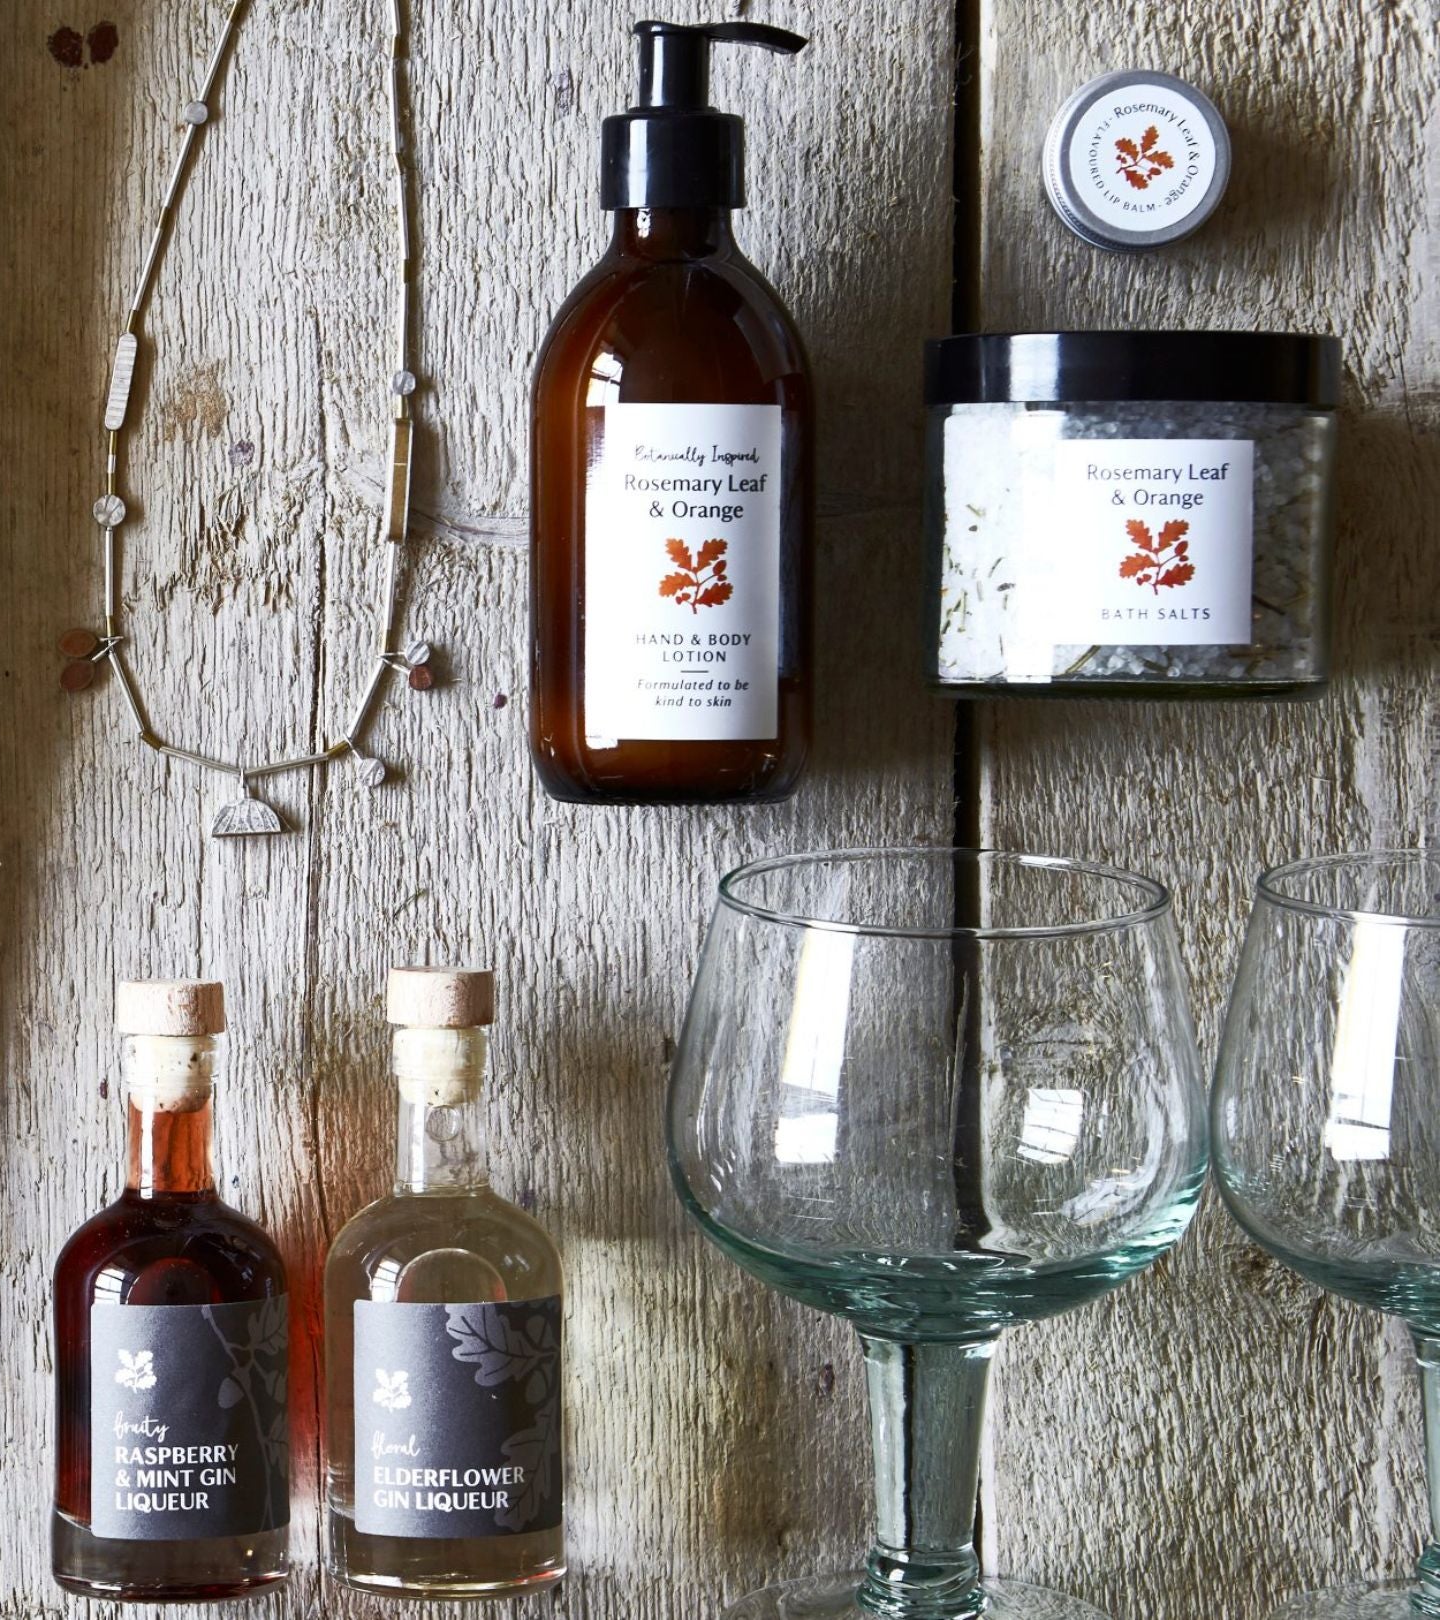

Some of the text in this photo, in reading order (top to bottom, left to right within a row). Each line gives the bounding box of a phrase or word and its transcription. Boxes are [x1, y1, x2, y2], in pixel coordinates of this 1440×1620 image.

[1113, 102, 1200, 206] Rosemary Leaf & Orange
[1089, 120, 1156, 213] FLAVOURED LIP BALM
[635, 445, 760, 467] Botanically Inspired
[1087, 463, 1230, 483] Rosemary Leaf
[624, 474, 768, 495] Rosemary Leaf
[1112, 489, 1204, 509] & Orange
[649, 500, 744, 522] & Orange
[1102, 608, 1211, 620] BATH SALTS
[635, 634, 751, 646] HAND & BODY
[662, 650, 726, 662] LOTION
[637, 679, 749, 691] Formulated to be
[656, 696, 732, 707] kind to skin
[113, 1410, 170, 1443] fruity
[115, 1444, 239, 1464] RASPBERRY
[371, 1430, 421, 1459] floral
[115, 1467, 237, 1487] & MINT GIN
[374, 1466, 525, 1487] ELDERFLOWER
[116, 1492, 209, 1512] LIQUEUR
[373, 1491, 509, 1512] GIN LIQUEUR
